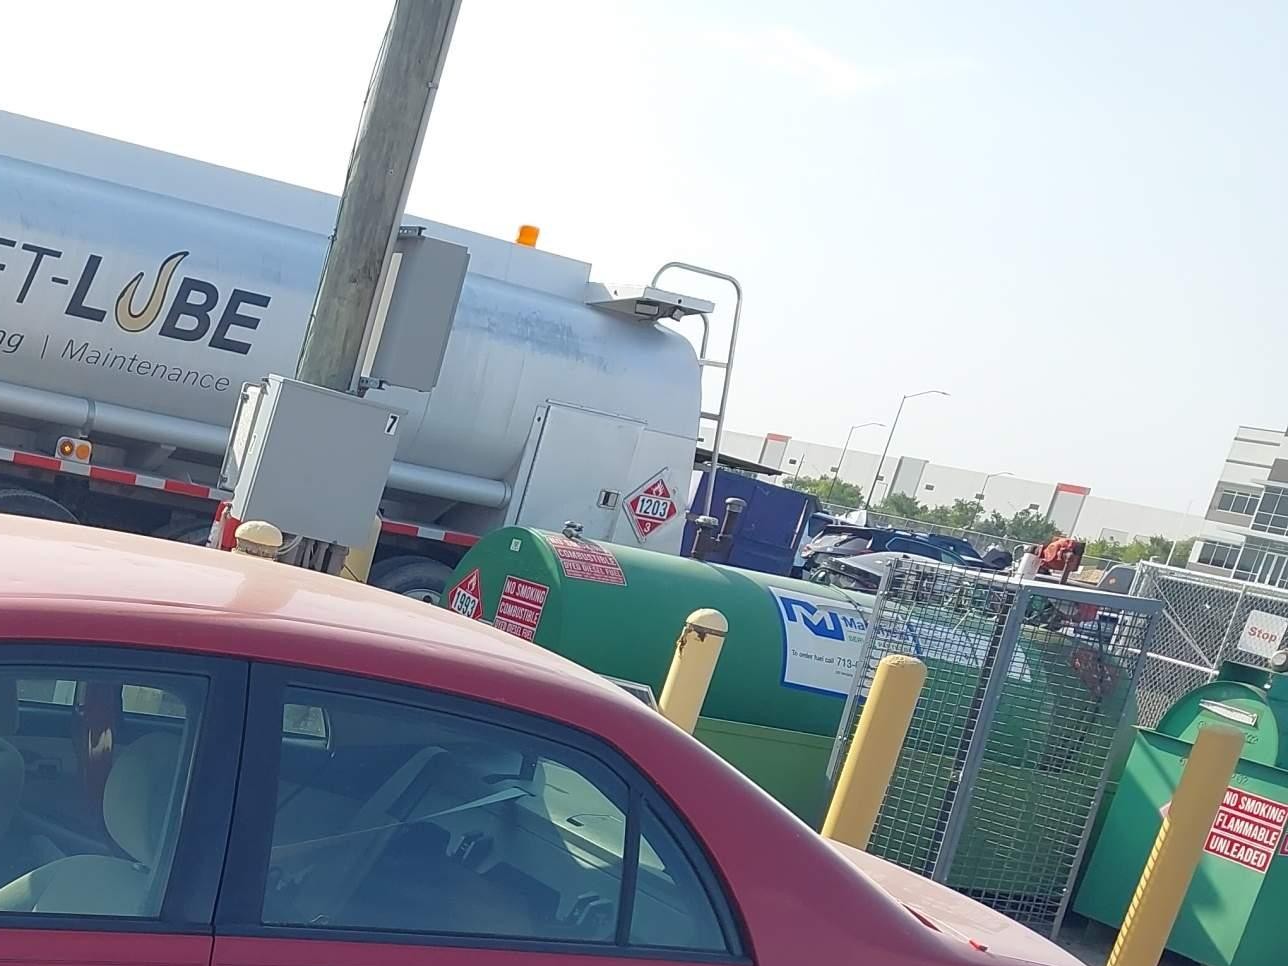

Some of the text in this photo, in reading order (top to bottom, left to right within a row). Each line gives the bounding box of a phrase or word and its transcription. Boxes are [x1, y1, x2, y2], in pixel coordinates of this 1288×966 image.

[60, 337, 231, 392] Maintenance
[386, 415, 398, 433] 7
[639, 498, 668, 517] 1203
[643, 522, 651, 533] 3
[557, 548, 616, 566] COMBUSTIBLE
[505, 580, 546, 603] NO SMOKING
[453, 590, 476, 617] 1993
[499, 602, 540, 625] COMBUSTIBLE
[1248, 626, 1278, 643] Stop
[1223, 791, 1286, 823] NO SMOKING
[1215, 812, 1279, 846] FLAMMABLE
[1209, 834, 1267, 869] UNLEADED
